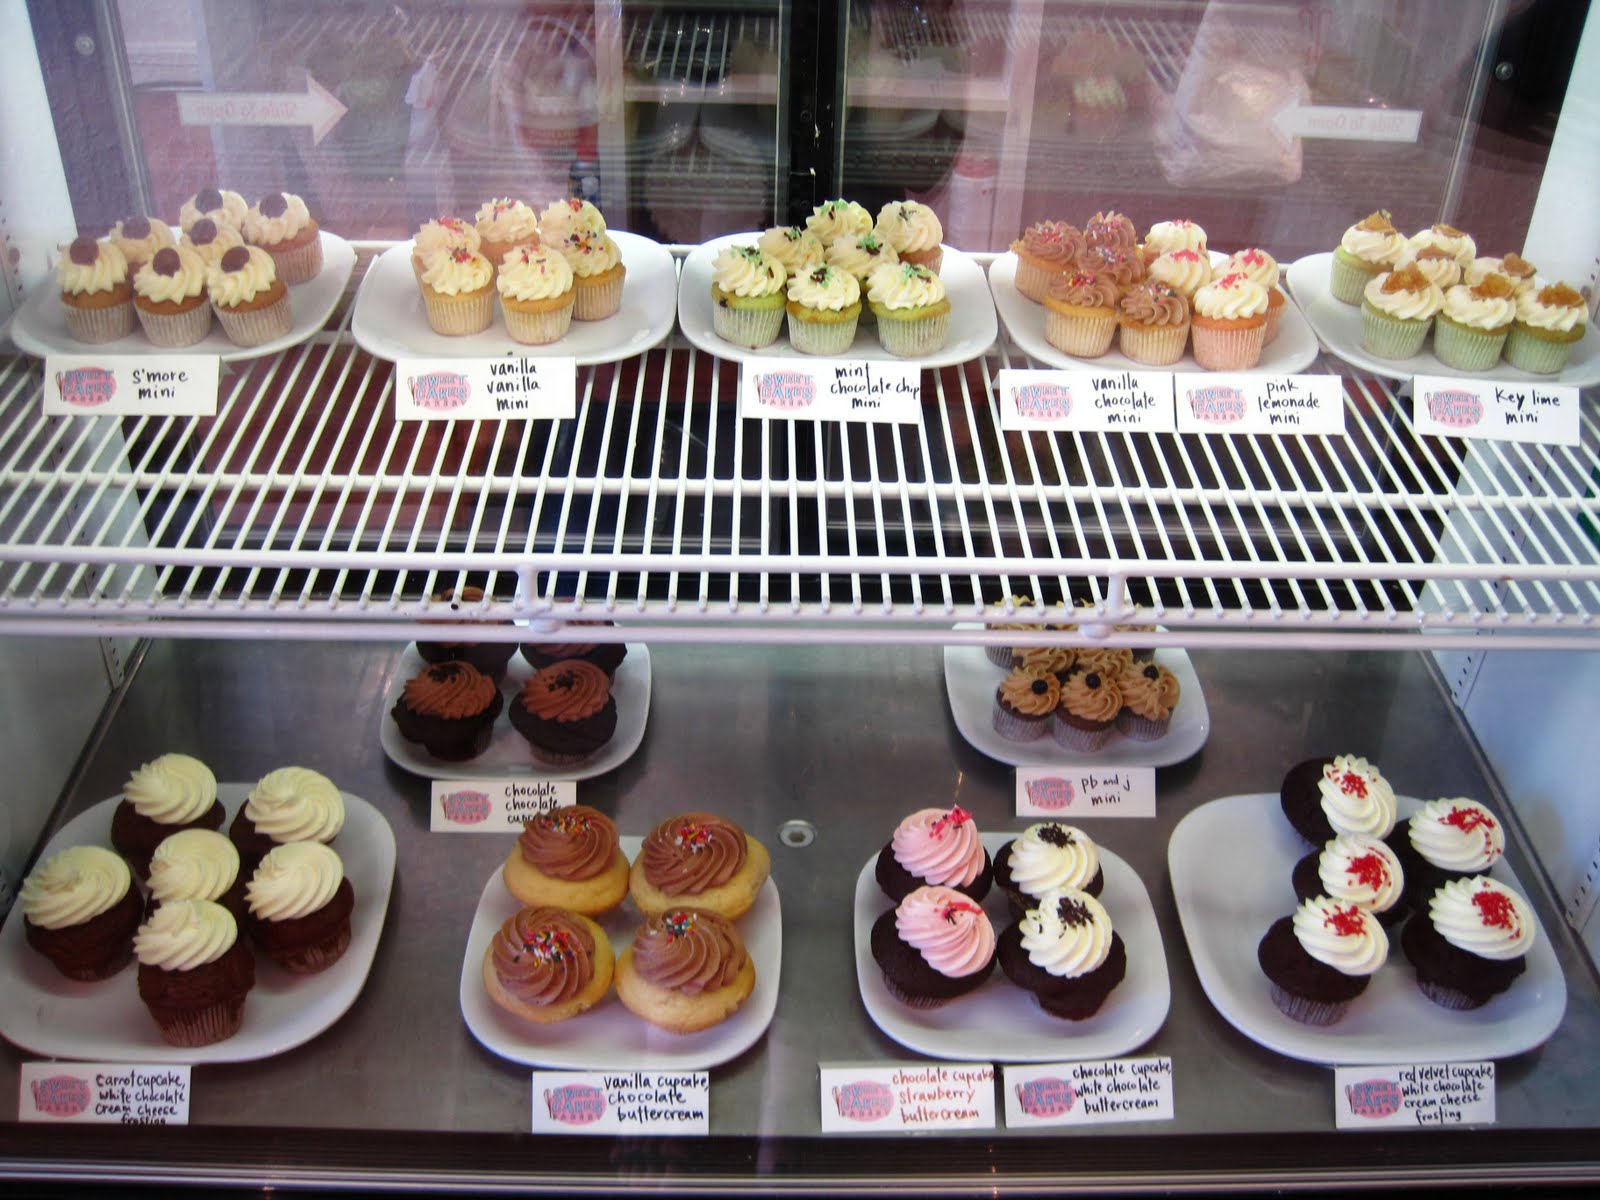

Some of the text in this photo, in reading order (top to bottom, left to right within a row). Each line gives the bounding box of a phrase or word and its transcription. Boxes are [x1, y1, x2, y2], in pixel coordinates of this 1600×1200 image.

[490, 358, 537, 375] vanilla
[132, 369, 188, 384] S'more
[417, 375, 468, 387] SWEET
[487, 376, 541, 394] vanilla
[763, 374, 812, 385] SWEET
[835, 363, 870, 394] mint
[1092, 373, 1138, 391] vanilla
[138, 385, 175, 399] mini
[830, 377, 919, 400] chocolate chip
[1020, 386, 1069, 398] SWEET
[1195, 389, 1242, 400] SWEET
[1266, 378, 1299, 398] pink
[497, 393, 528, 411] mini
[852, 397, 880, 408] mini
[1095, 392, 1156, 409] chocolate
[1258, 392, 1320, 412] lemonade
[1433, 392, 1480, 403] SWEET
[1532, 389, 1560, 406] lime
[1108, 410, 1141, 423] mini
[1270, 410, 1300, 424] mini
[1505, 411, 1538, 425] mini
[505, 782, 557, 796] chocolate
[1081, 774, 1130, 793] pb and j
[1091, 792, 1120, 806] mini
[893, 1067, 948, 1085] chocolate
[1073, 1062, 1125, 1079] chocolate
[1399, 1065, 1415, 1083] red
[1418, 1064, 1448, 1080] velvet
[657, 1074, 709, 1092] cupcake,
[1024, 1080, 1072, 1094] SWEET
[1075, 1077, 1160, 1098] white chocolate
[1402, 1079, 1484, 1097] white chocolate
[99, 1088, 184, 1105] white chocolate
[553, 1088, 603, 1101] SWEET
[608, 1088, 686, 1104] chocolate
[900, 1086, 975, 1104] strawberry
[1404, 1094, 1480, 1108] cream cheese
[138, 1105, 177, 1116] cheese
[901, 1106, 979, 1124] buttercream
[1084, 1099, 1158, 1114] buttercream
[617, 1107, 703, 1124] buttercream
[1416, 1107, 1461, 1126] frosting
